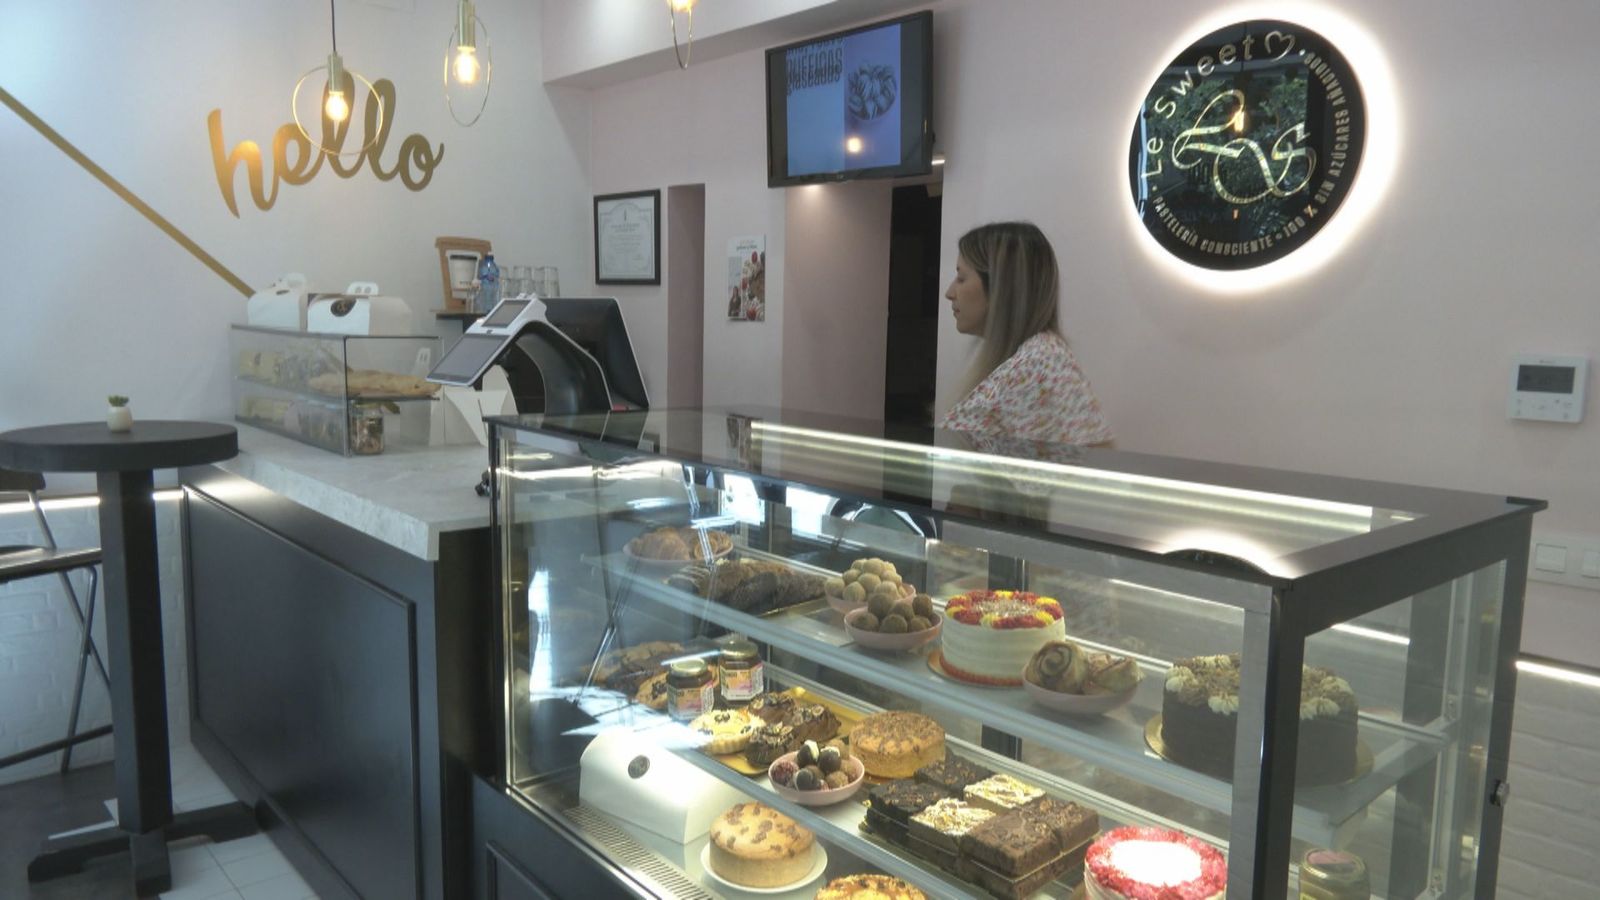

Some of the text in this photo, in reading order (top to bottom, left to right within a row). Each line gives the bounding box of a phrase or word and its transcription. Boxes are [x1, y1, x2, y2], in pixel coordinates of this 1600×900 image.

[207, 70, 444, 219] hello
[1141, 34, 1255, 178] Le Sweet
[1200, 234, 1274, 256] CONSCIENTE
